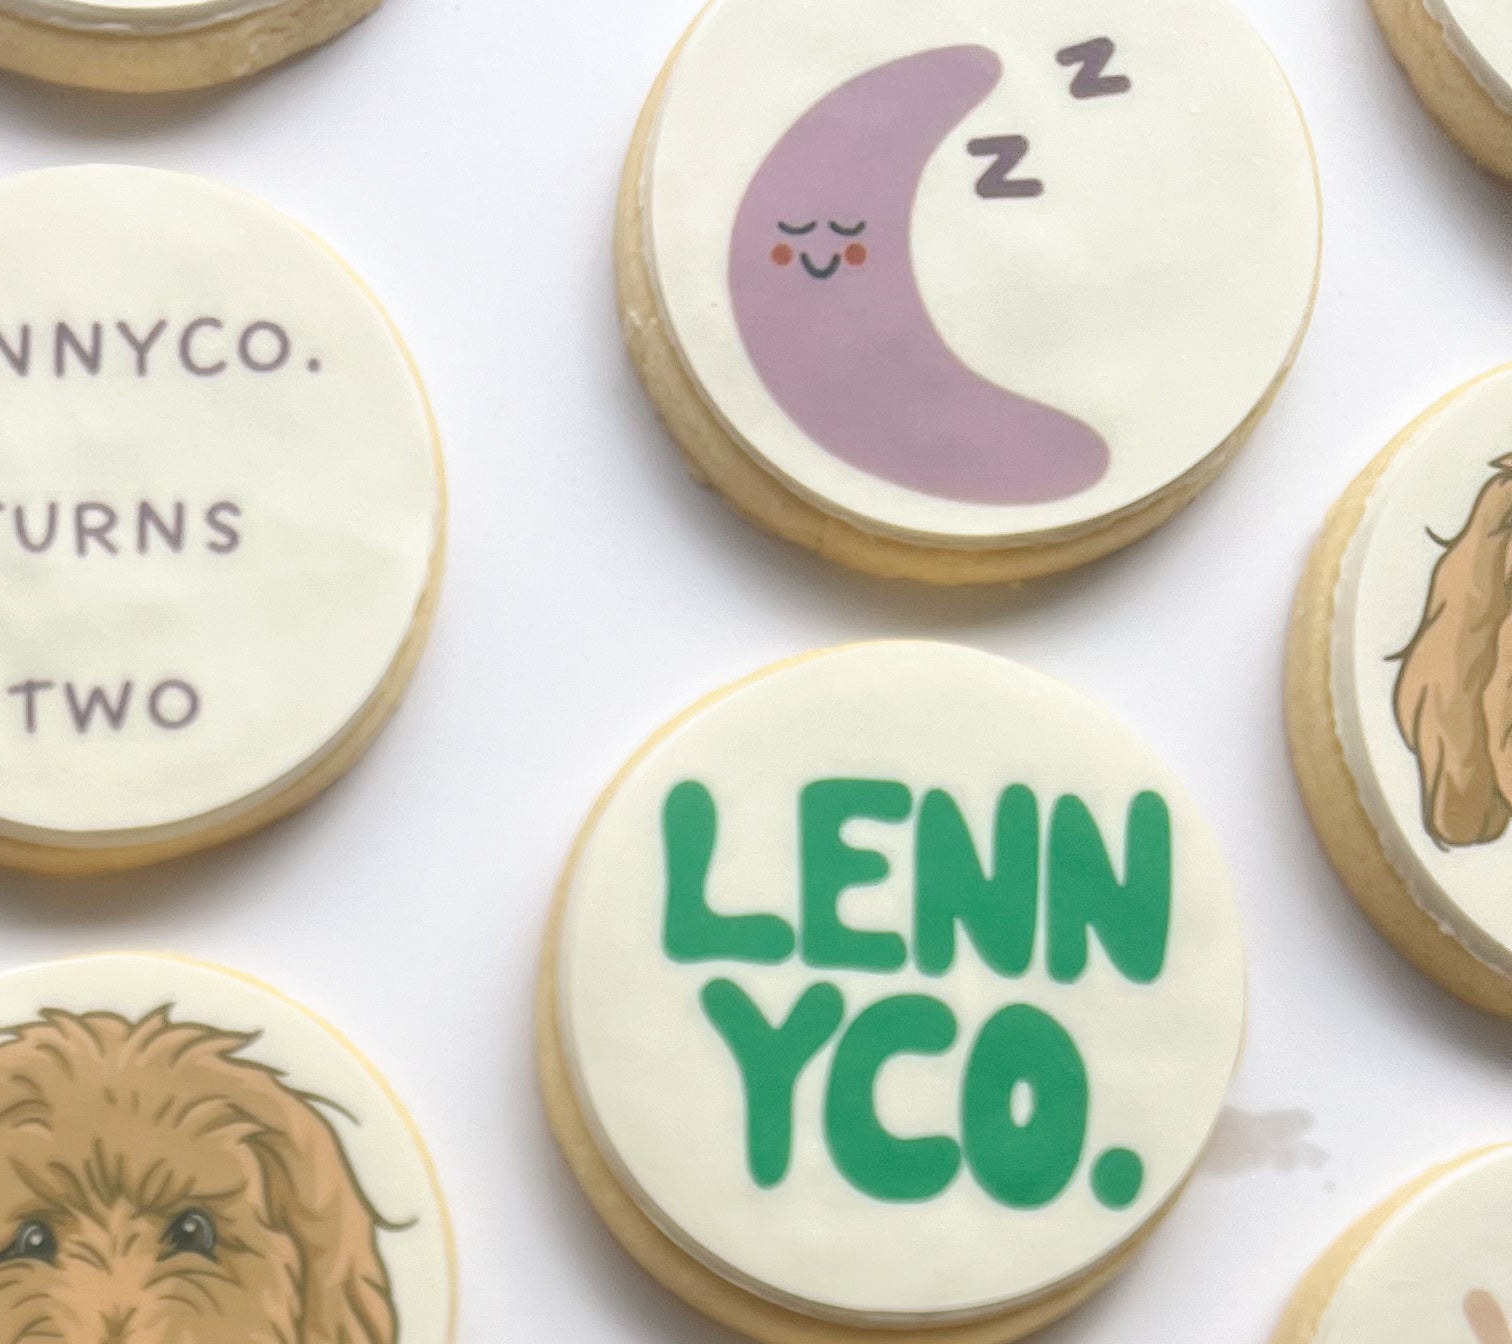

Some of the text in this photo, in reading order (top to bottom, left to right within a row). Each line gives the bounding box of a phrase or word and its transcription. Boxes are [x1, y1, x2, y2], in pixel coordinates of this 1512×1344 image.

[6, 677, 202, 735] TWO
[665, 779, 1172, 981] LENN
[703, 980, 1143, 1208] YCO.
